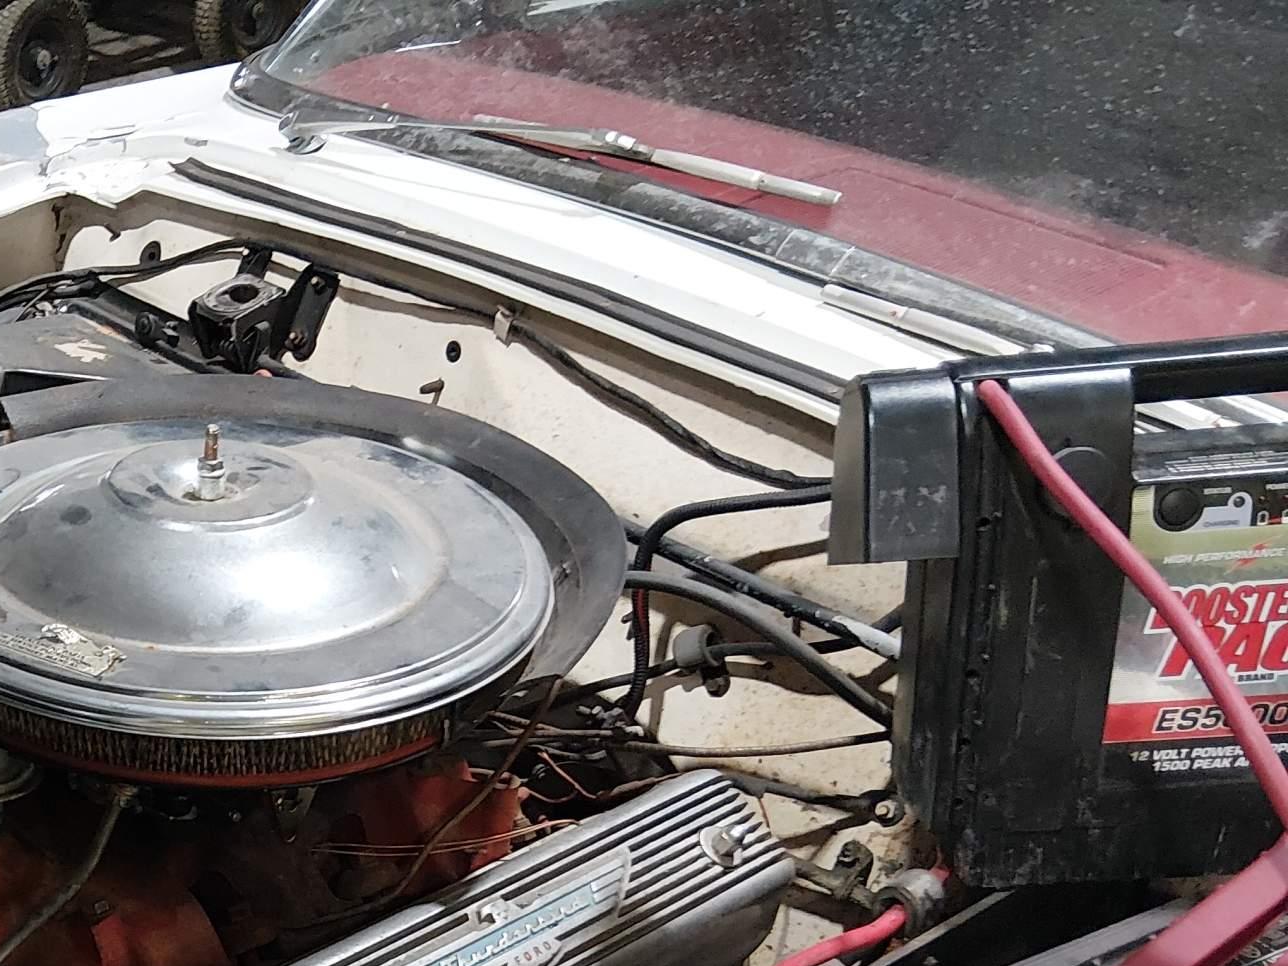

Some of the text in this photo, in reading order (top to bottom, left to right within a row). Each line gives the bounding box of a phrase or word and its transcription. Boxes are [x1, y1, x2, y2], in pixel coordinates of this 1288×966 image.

[1153, 702, 1288, 732] ES500
[1130, 751, 1150, 762] 12
[1153, 748, 1187, 760] VOLT
[1152, 759, 1190, 772] 1500
[1192, 757, 1234, 770] PEAK
[514, 941, 552, 963] FORD
